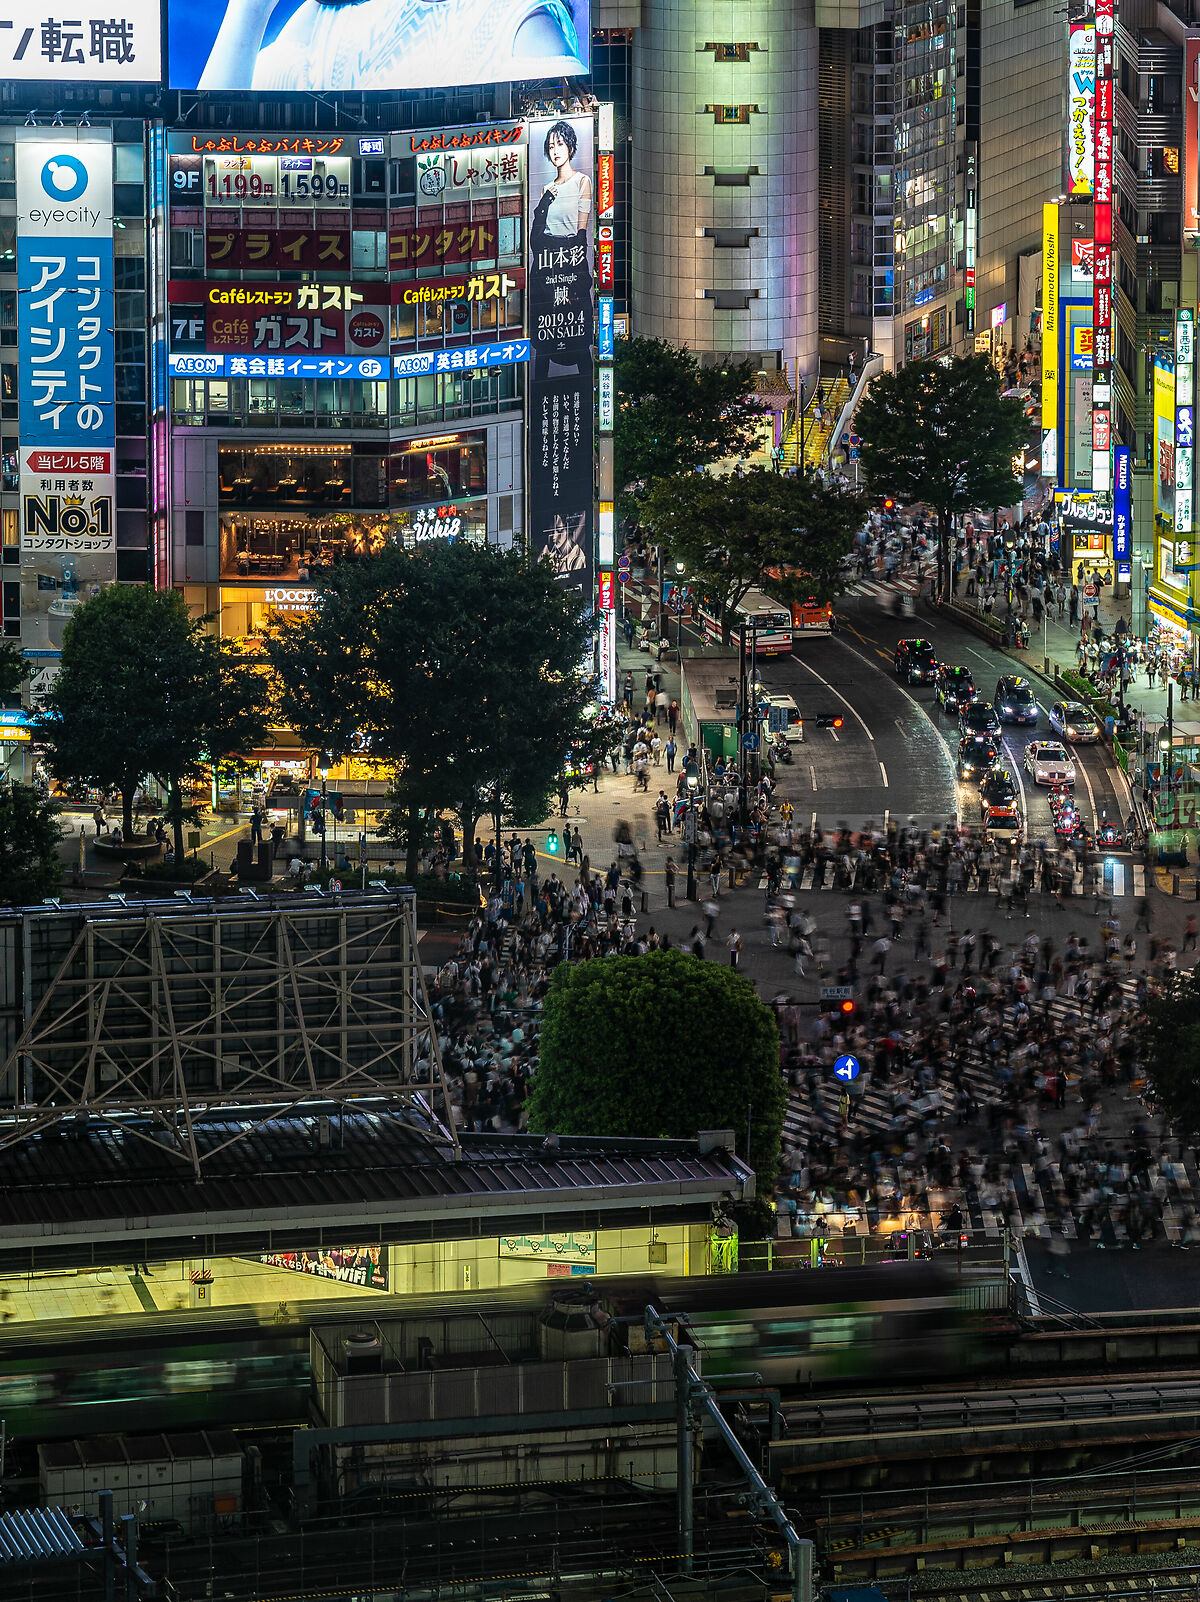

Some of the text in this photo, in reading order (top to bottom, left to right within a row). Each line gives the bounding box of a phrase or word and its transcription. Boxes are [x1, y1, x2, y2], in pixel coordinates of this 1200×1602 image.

[192, 136, 344, 154] しゃぶしゃぶバイキング
[360, 140, 383, 153] 寿司
[410, 126, 524, 152] しゃぶしゃぶバイキング
[223, 158, 248, 168] ランチ
[283, 158, 312, 168] ディナー
[453, 152, 519, 186] しゃぶ葉
[173, 171, 200, 189] 9F
[208, 174, 273, 204] 1,199円
[281, 174, 350, 204] 1,599円
[29, 207, 101, 228] eyecity
[208, 233, 345, 260] プライス
[389, 226, 494, 259] コンタクト
[538, 245, 585, 270] 山本彩
[546, 272, 578, 285] 2nd Single
[601, 253, 611, 284] ガスト
[467, 274, 517, 302] ガスト
[1046, 233, 1055, 332] Matsumoto KiYoshi
[208, 288, 293, 305] Caféレストラン
[297, 284, 363, 311] ガスト
[404, 286, 465, 305] Caféレストラン
[172, 319, 205, 339] 7F
[212, 319, 249, 334] Café
[538, 311, 585, 329] 2019.9.4
[601, 303, 611, 355] 英会話イーオン
[213, 335, 249, 344] レストラン
[254, 315, 337, 349] ガスト
[353, 327, 382, 338] ガスト
[538, 324, 585, 341] ON SALE
[29, 256, 68, 430] アイシティ
[77, 256, 104, 431] コンタクトの
[176, 358, 216, 373] AEON
[230, 358, 379, 376] 英会話イーオン 6F
[398, 357, 429, 374] AEON
[437, 344, 527, 371] 英会話イーオン
[602, 373, 611, 425] 渋谷駅前ビル
[37, 456, 105, 471] 当ビル5階
[1119, 454, 1128, 489] MIZUHO
[40, 479, 94, 492] 利用者数
[24, 494, 112, 537] No.1
[1062, 494, 1114, 525] グルメタウン
[23, 538, 113, 550] コンタクトショップ
[1117, 515, 1126, 552] みずほ銀行
[264, 588, 326, 603] L'OCCIT
